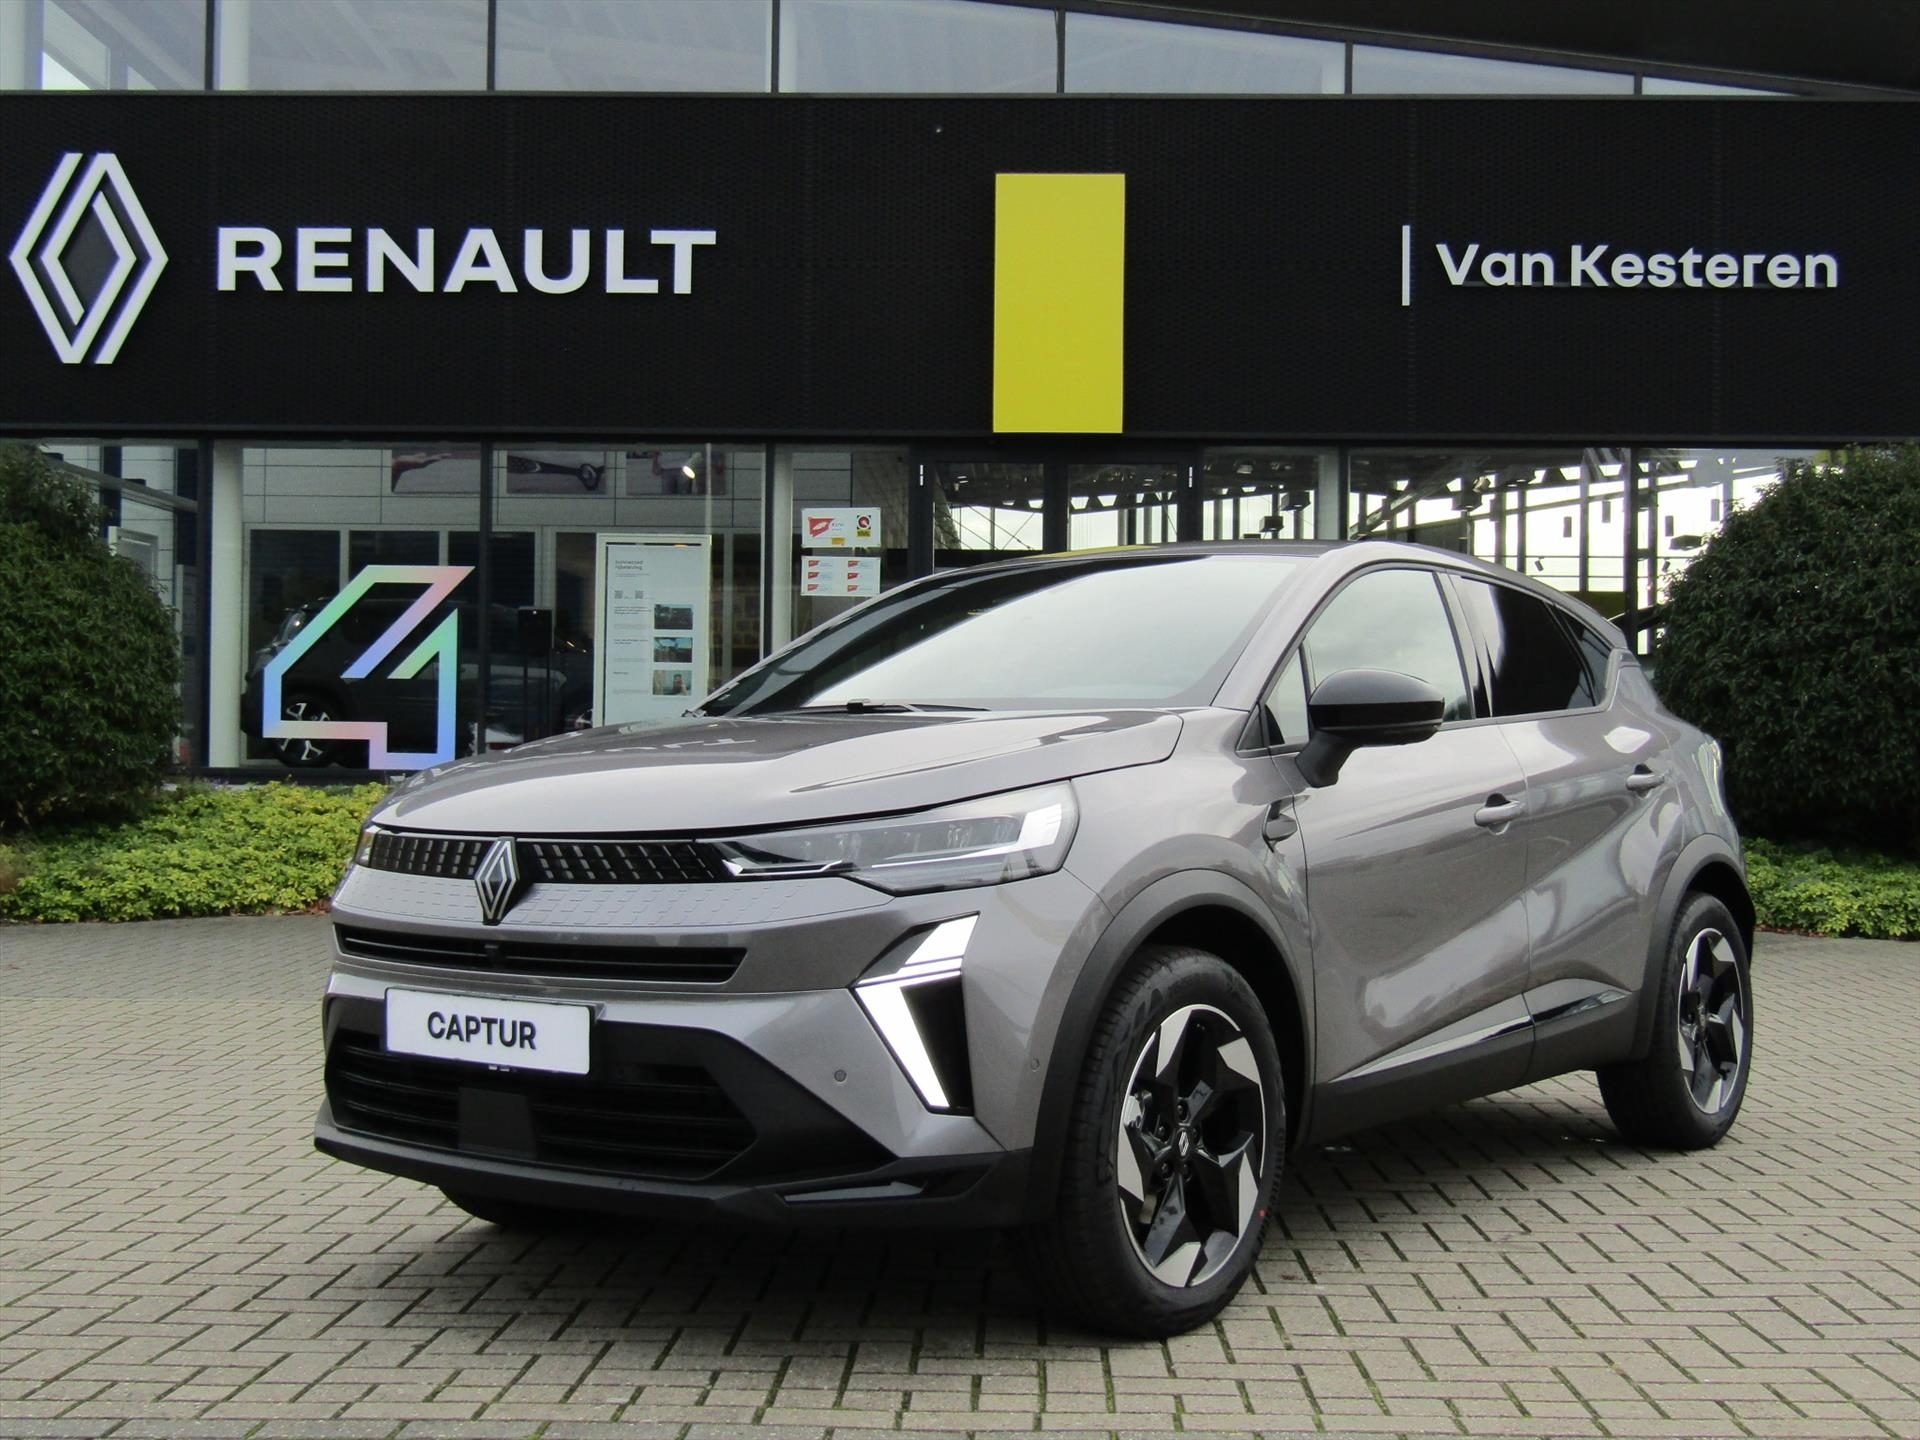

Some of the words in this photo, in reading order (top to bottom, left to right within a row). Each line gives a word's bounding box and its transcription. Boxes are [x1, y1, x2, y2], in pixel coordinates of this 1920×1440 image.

[217, 226, 716, 295] RENAULT
[1435, 243, 1555, 287] Van
[1570, 244, 1838, 289] Kesteren
[427, 1011, 537, 1050] CAPTUR
